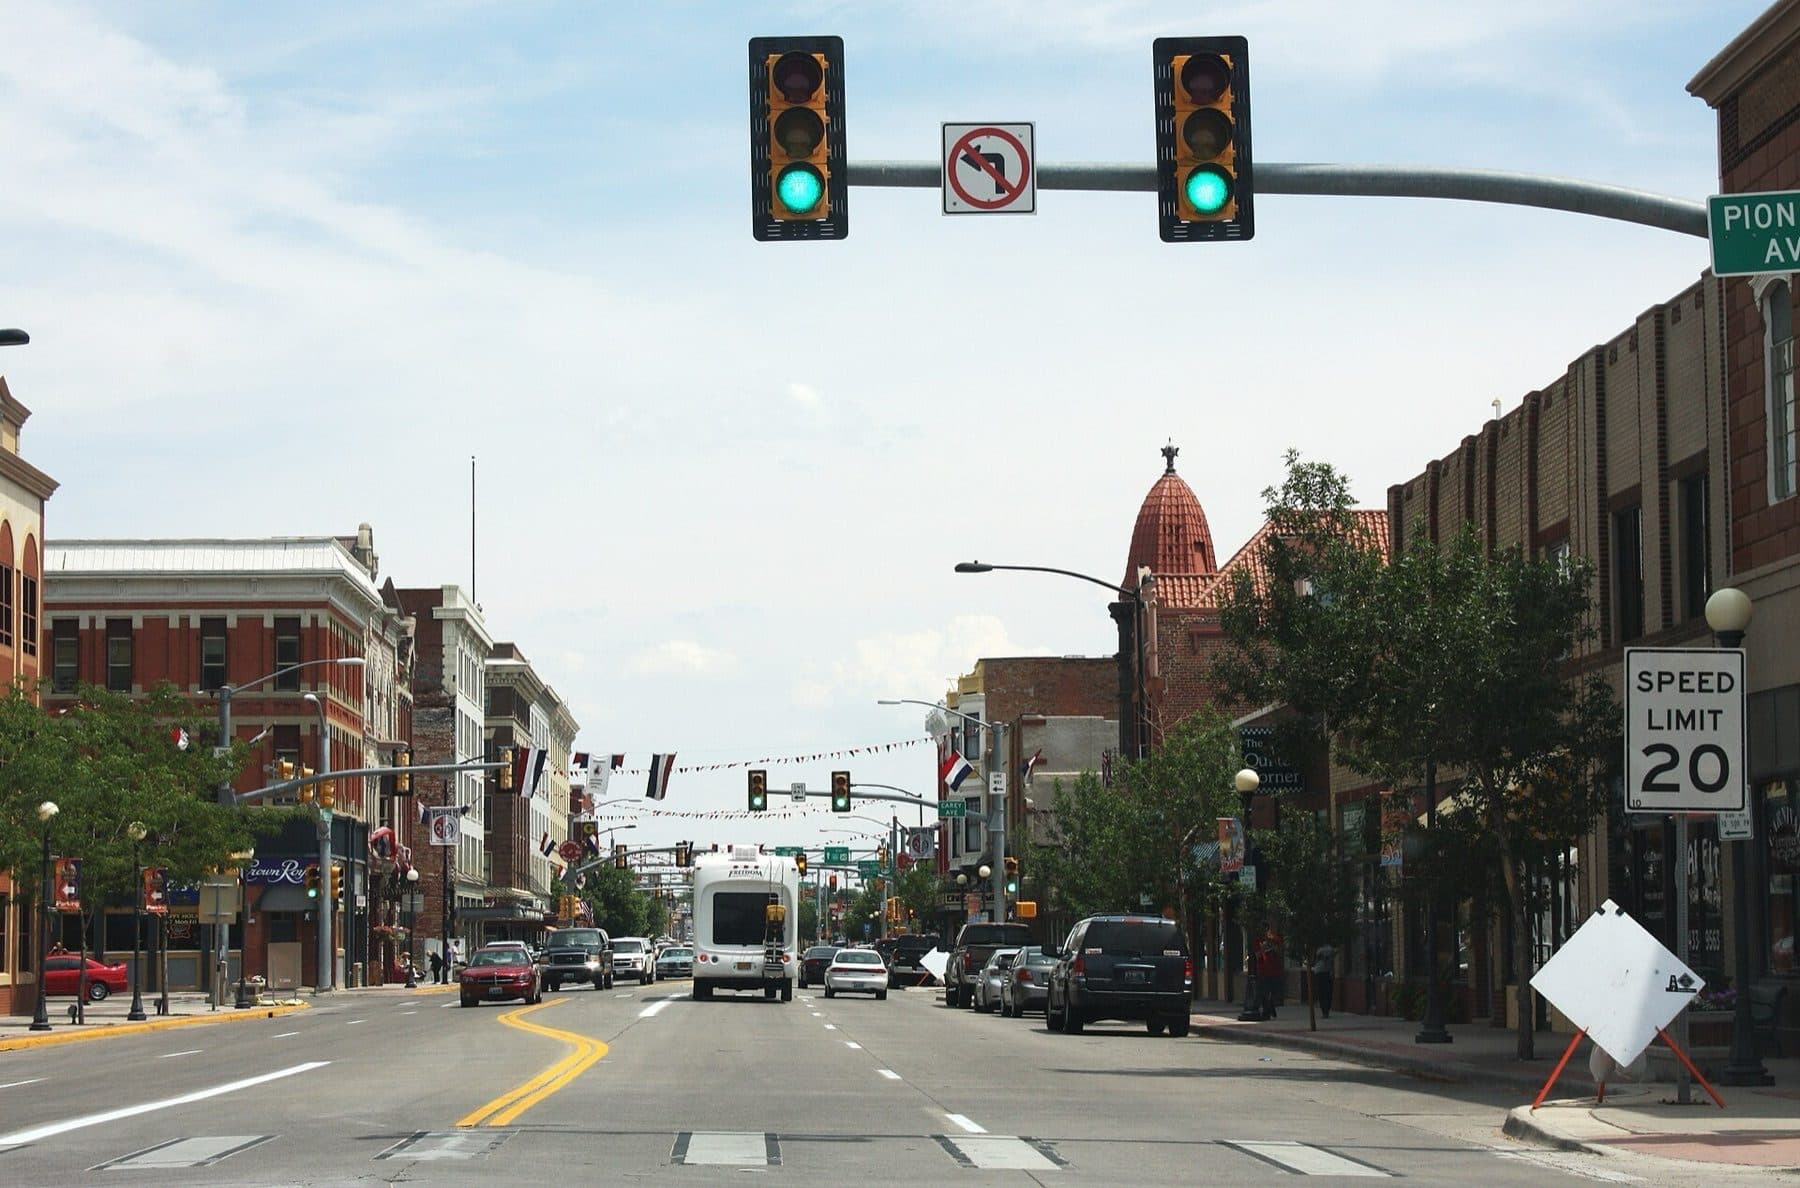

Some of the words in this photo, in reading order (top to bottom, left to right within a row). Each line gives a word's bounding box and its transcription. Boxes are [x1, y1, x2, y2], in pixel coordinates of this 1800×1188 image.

[1724, 202, 1796, 231] PION
[1764, 237, 1800, 264] AV
[1637, 671, 1735, 694] SPEED
[1648, 708, 1723, 732] LIMIT
[1245, 738, 1263, 748] The
[1259, 772, 1299, 784] orner
[1641, 743, 1730, 794] 20
[267, 859, 307, 884] Roy
[728, 870, 763, 878] FREEDOM
